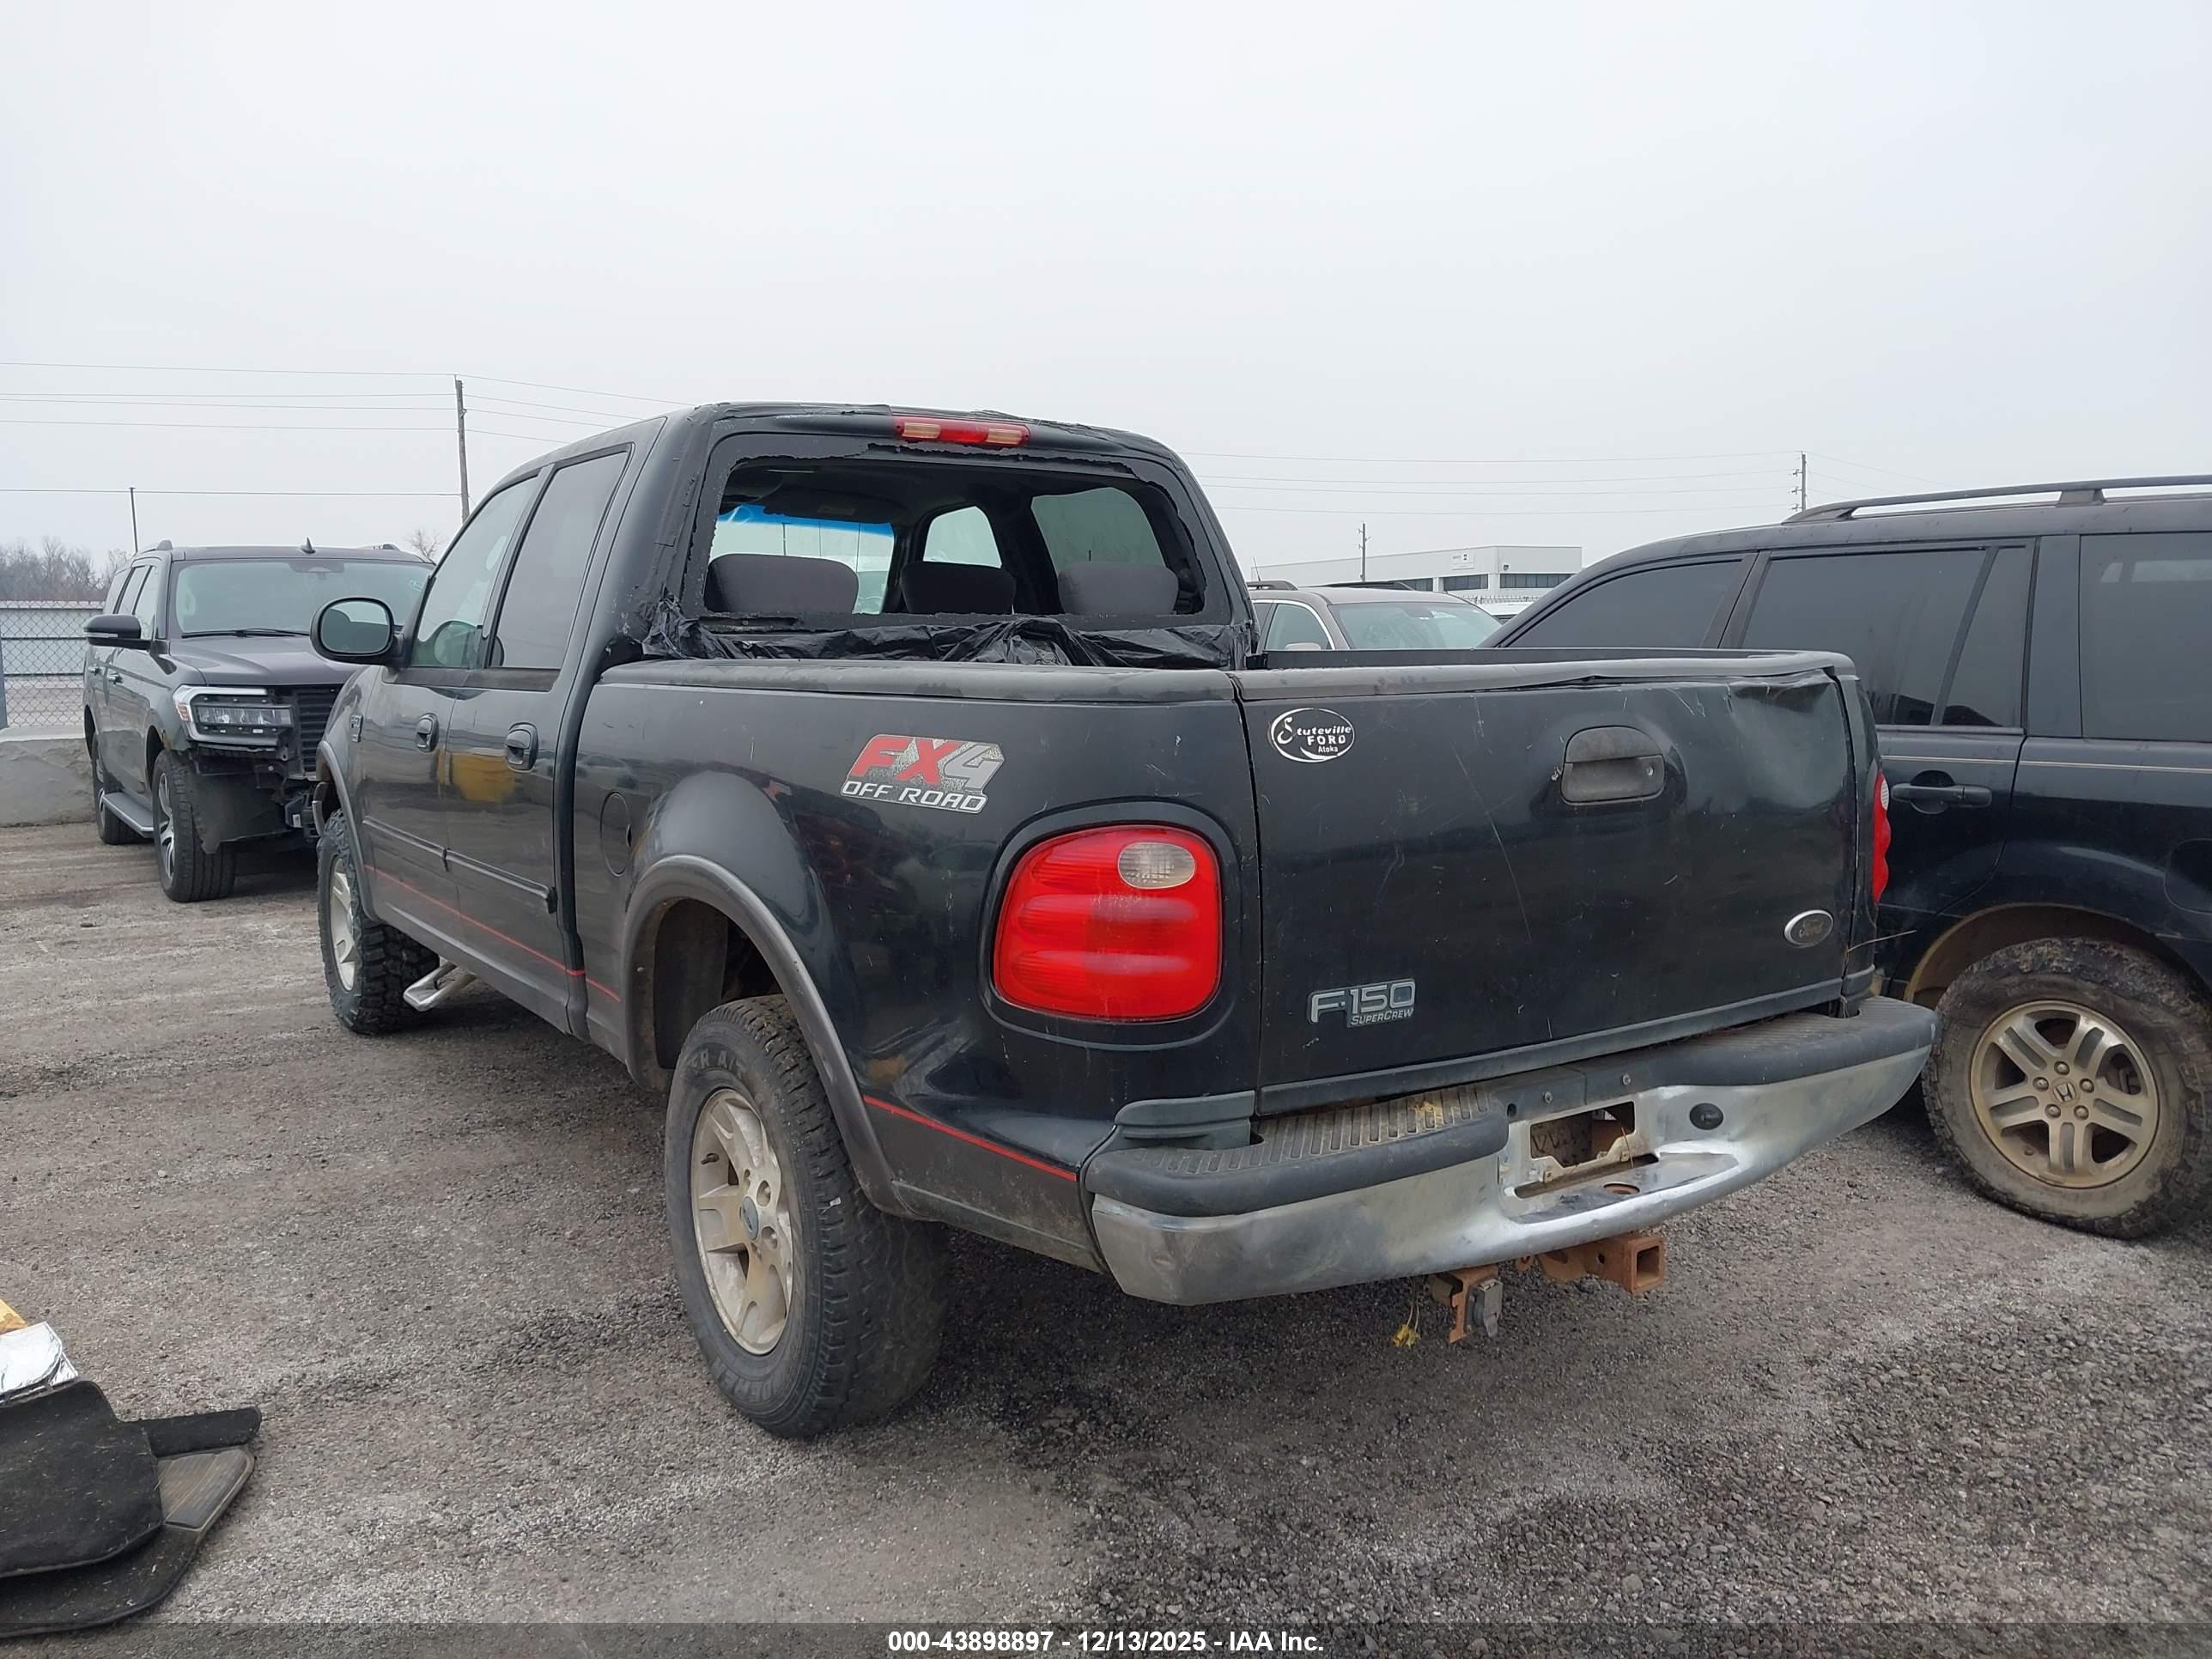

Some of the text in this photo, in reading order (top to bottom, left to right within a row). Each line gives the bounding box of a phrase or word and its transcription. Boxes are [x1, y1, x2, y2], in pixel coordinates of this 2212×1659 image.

[1307, 735, 1346, 746] FORD
[851, 737, 1002, 789] FX4
[842, 781, 988, 811] OFF ROAD
